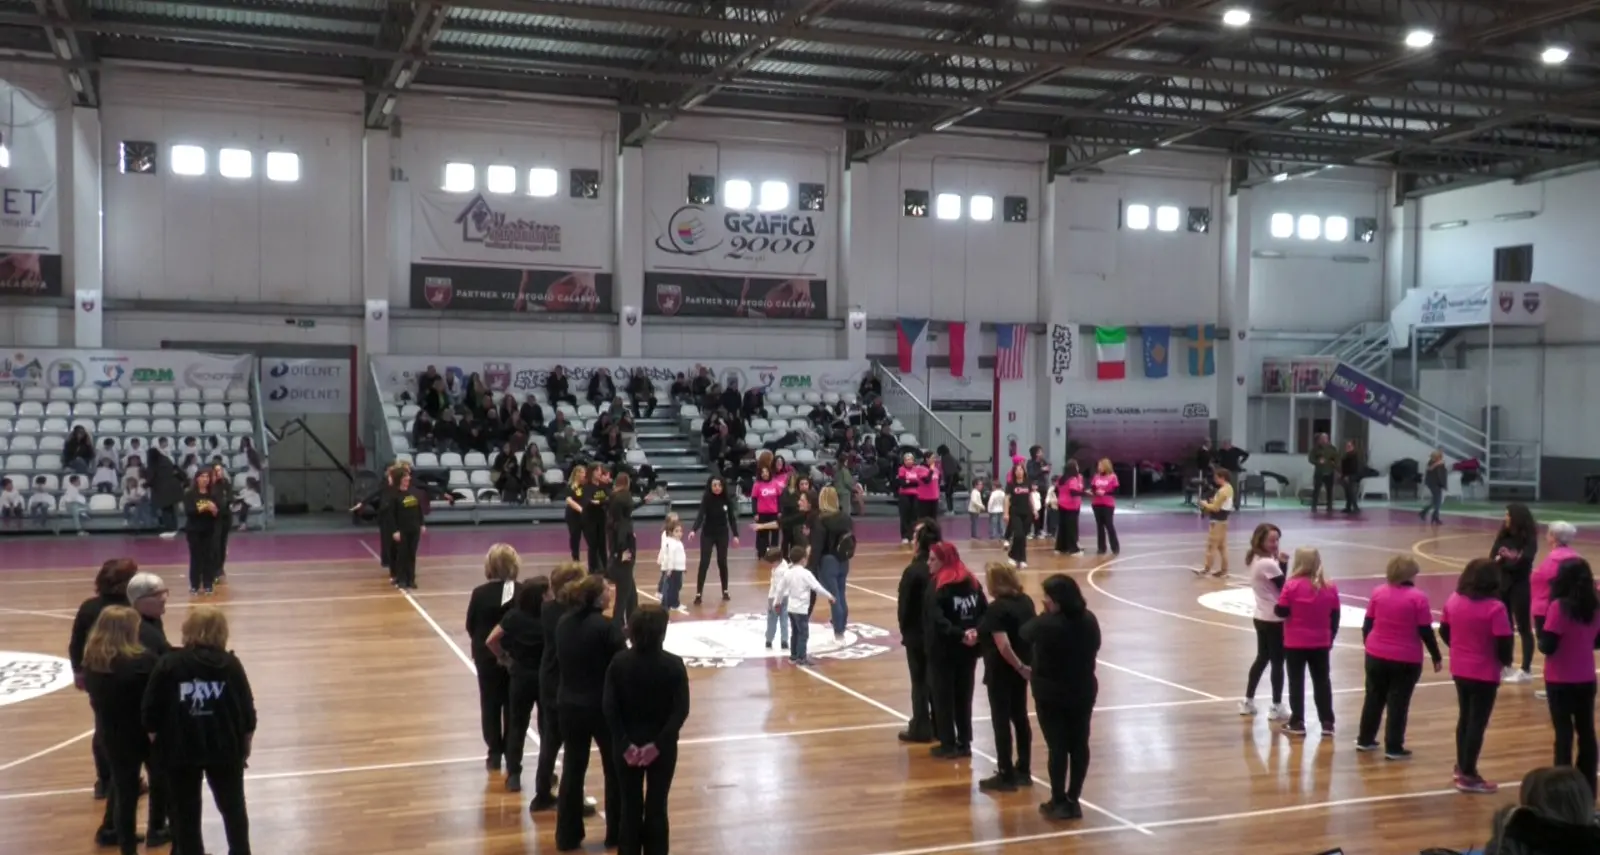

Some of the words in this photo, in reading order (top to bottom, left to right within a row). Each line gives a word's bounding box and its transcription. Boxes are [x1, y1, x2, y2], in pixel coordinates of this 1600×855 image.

[724, 236, 815, 259] 2000
[456, 289, 498, 299] PARTNER
[518, 292, 553, 301] REGGIO
[557, 293, 601, 303] CALABRIA
[685, 296, 722, 306] PARTNER
[741, 299, 773, 308] REGGIO
[775, 300, 816, 309] CALABRIA
[291, 365, 343, 377] DIELNET
[290, 388, 342, 400] DIELNET
